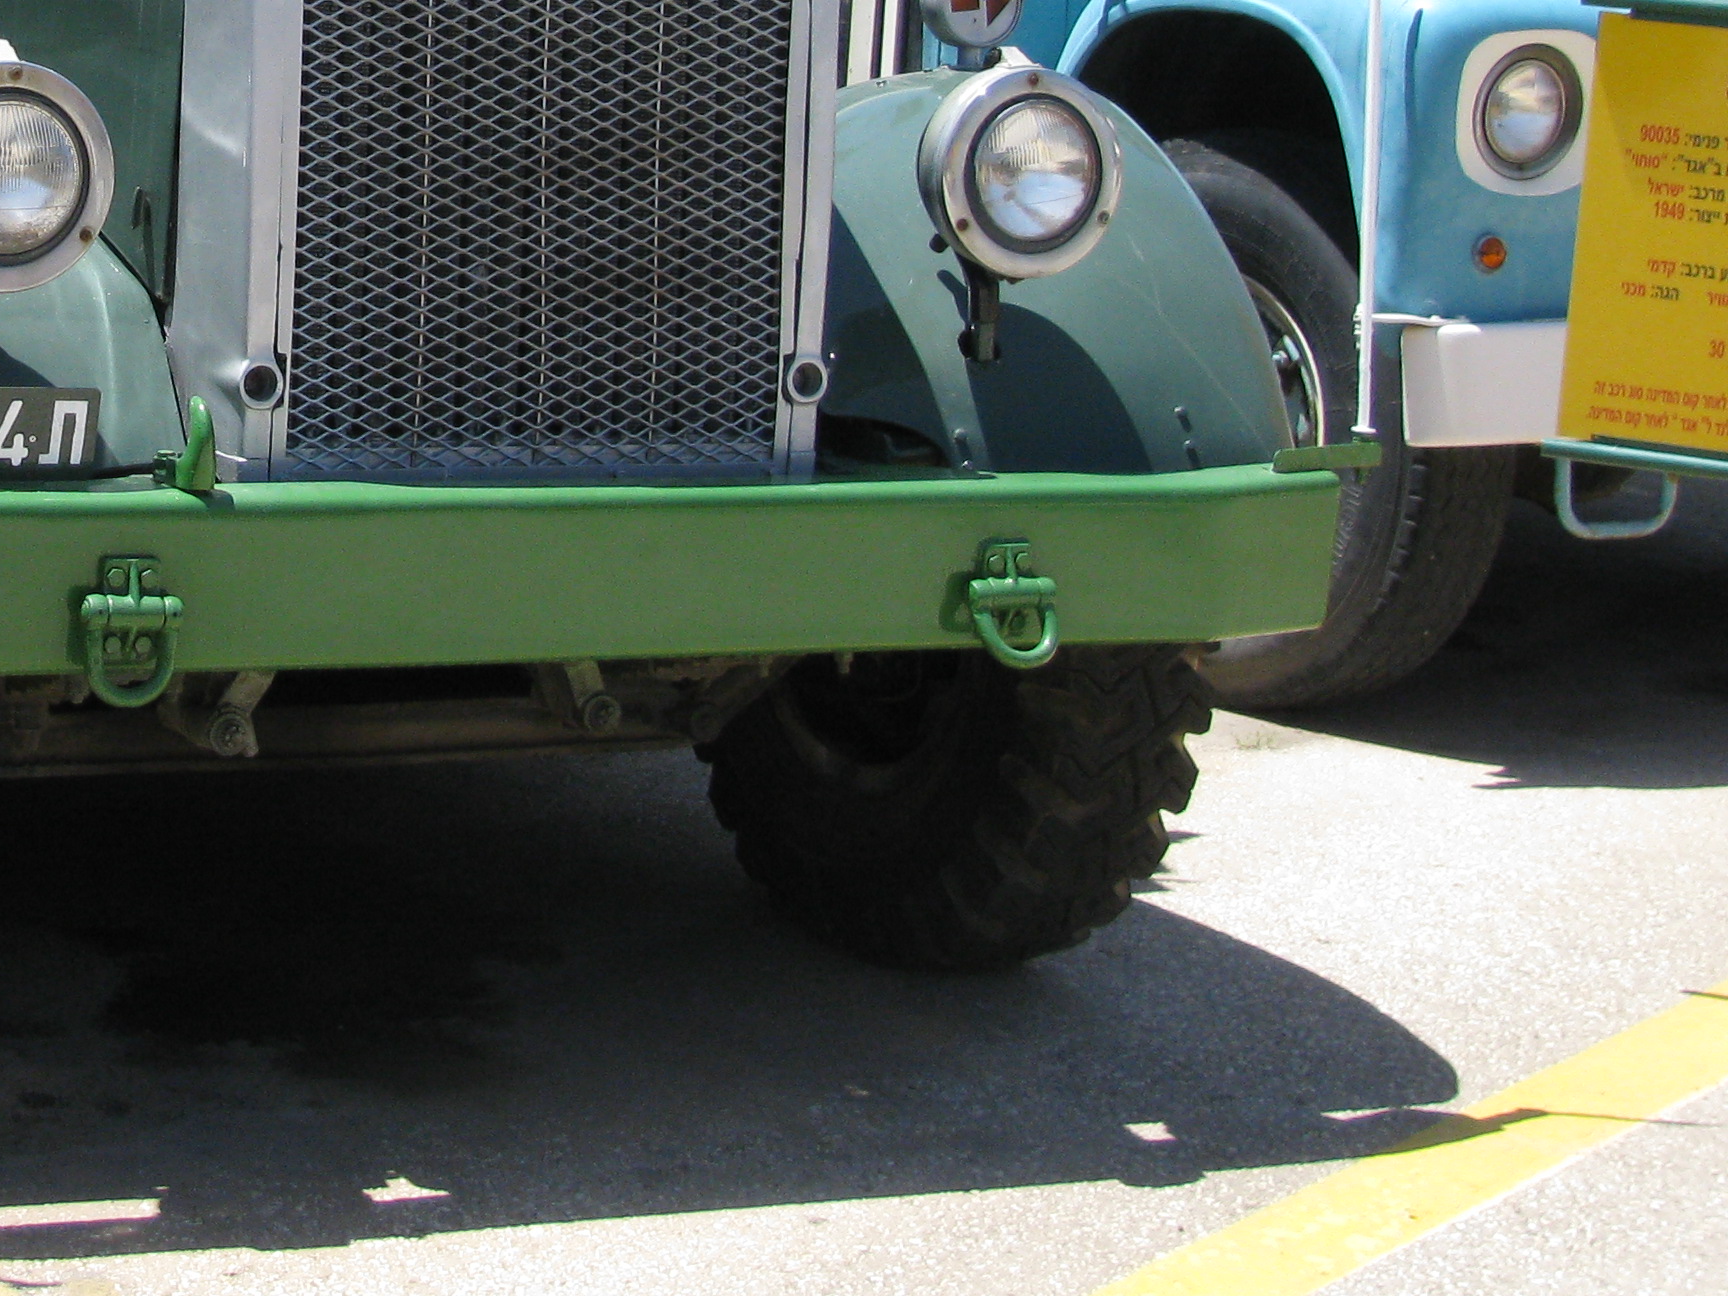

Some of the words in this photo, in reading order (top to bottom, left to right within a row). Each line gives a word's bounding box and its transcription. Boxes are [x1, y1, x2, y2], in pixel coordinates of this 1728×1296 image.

[1639, 124, 1680, 145] 90035
[1648, 177, 1685, 197] ישראל
[1654, 200, 1685, 220] 1949
[1648, 259, 1676, 278] קדמי
[1621, 282, 1646, 297] מכני
[1709, 339, 1725, 359] 30
